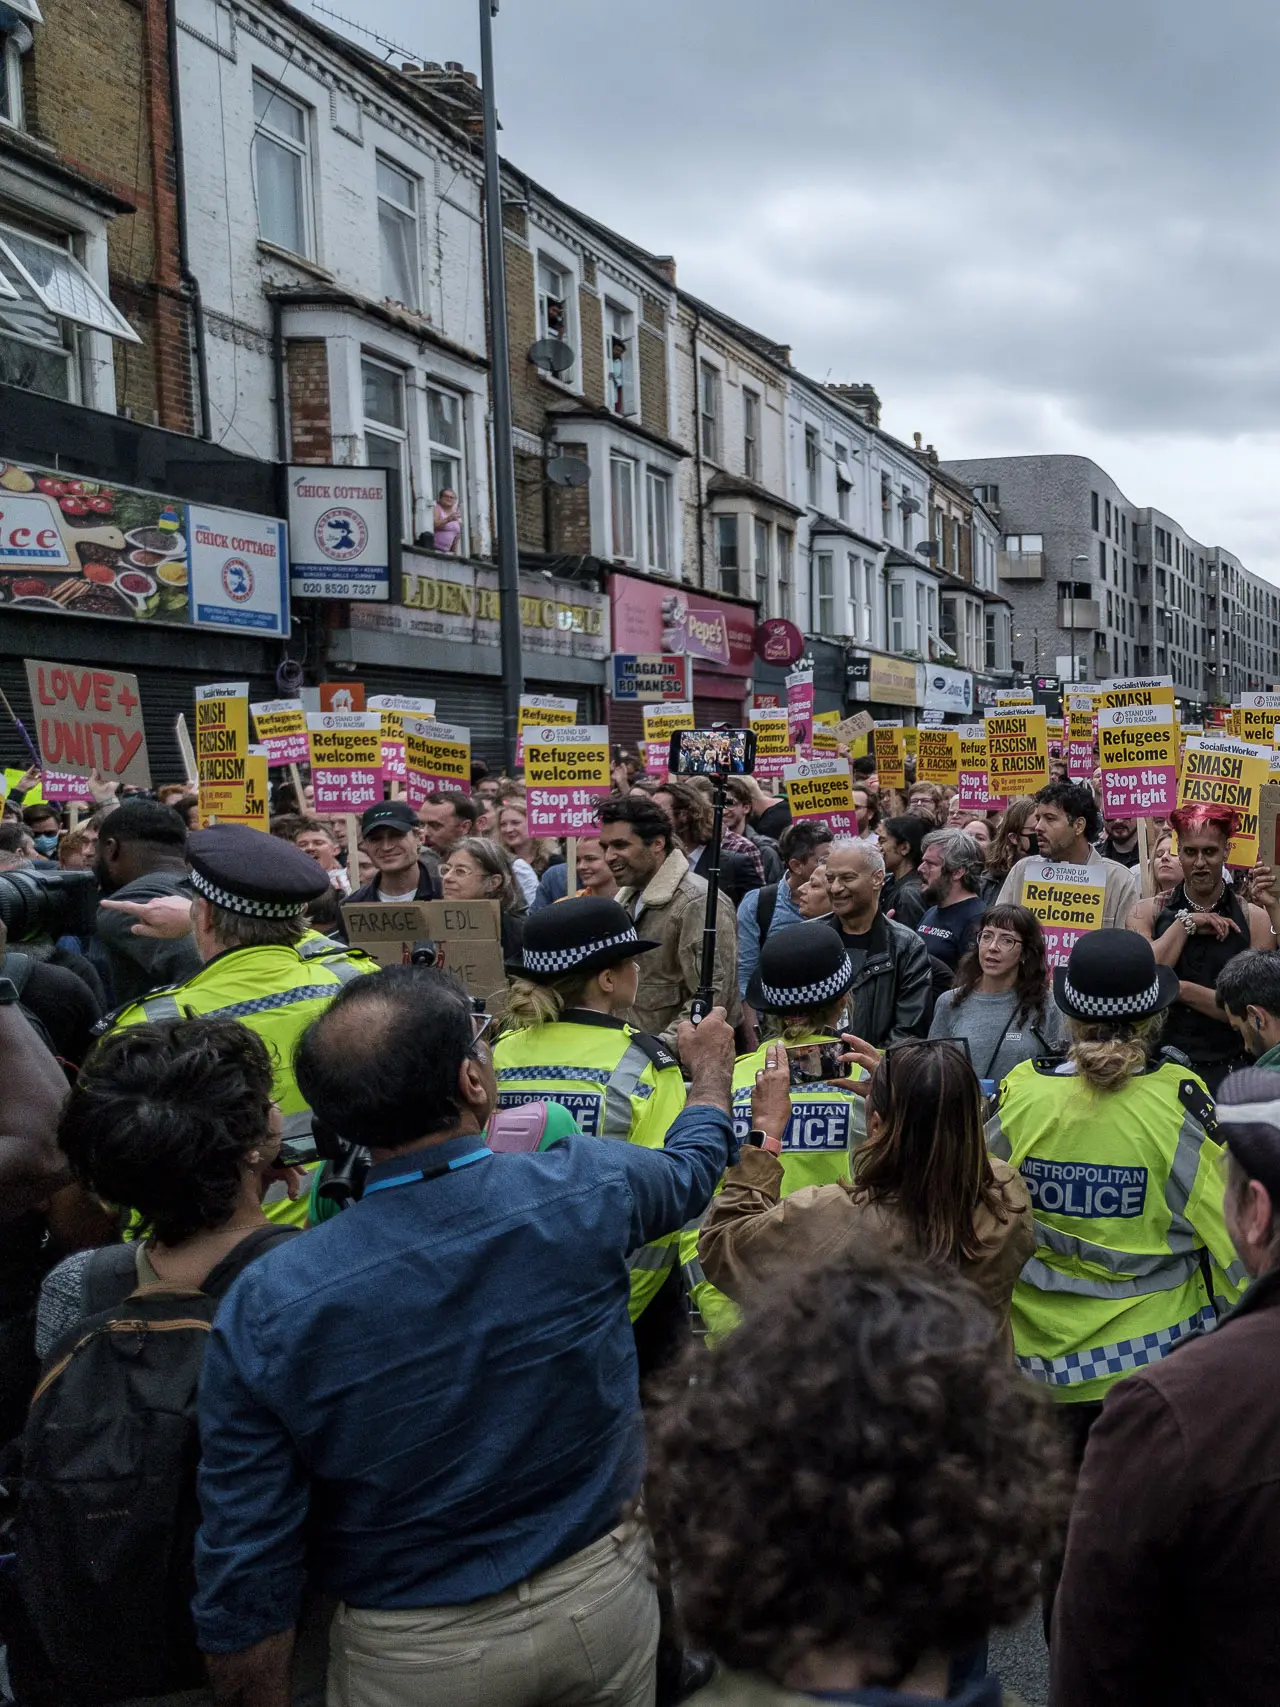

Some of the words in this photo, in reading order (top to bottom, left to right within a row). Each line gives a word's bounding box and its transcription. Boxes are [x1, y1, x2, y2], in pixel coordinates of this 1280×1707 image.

[297, 485, 331, 498] CHICK
[334, 486, 383, 500] COTTAGE
[196, 530, 229, 549] CHICK
[232, 537, 276, 558] COTTAGE
[304, 582, 322, 594] 020
[325, 584, 349, 594] 8520
[352, 584, 377, 595] 7337
[689, 615, 723, 646] Pepe's
[624, 663, 676, 674] MAGAZIN
[37, 667, 115, 711] LOVE
[117, 685, 138, 716] +
[619, 679, 681, 692] ROMANESC
[1106, 692, 1152, 709] SMASH
[257, 713, 303, 726] Refugees
[522, 708, 573, 724] Refugees
[260, 722, 303, 734] welcome
[648, 718, 692, 730] Refugees
[753, 722, 786, 733] Oppose
[988, 719, 1026, 734] SMASH
[264, 738, 284, 752] Stop
[286, 736, 305, 746] the
[313, 732, 378, 748] Refugees
[920, 732, 947, 743] SMASH
[1102, 730, 1170, 747] Refugees
[40, 718, 143, 775] UNITY
[284, 745, 307, 758] right
[407, 736, 468, 760] Refugees
[919, 746, 953, 756] FASCISM
[990, 738, 1036, 753] FASCISM
[315, 750, 376, 763] welcome
[529, 747, 606, 768] Refugees
[1104, 748, 1168, 763] welcome
[408, 754, 464, 774] welcome
[927, 760, 957, 770] RACISM
[990, 760, 999, 772] &
[1003, 756, 1045, 771] RACISM
[1186, 753, 1243, 779] SMASH
[316, 772, 348, 787] Stop
[351, 772, 375, 785] the
[530, 766, 602, 781] welcome
[961, 774, 980, 788] Stop
[1105, 772, 1138, 790] Stop
[1141, 768, 1167, 785] the
[409, 772, 436, 793] Stop
[790, 781, 848, 796] Refugees
[318, 789, 340, 802] far
[342, 787, 376, 804] right
[530, 790, 568, 808] Stop
[961, 790, 973, 801] far
[1107, 791, 1128, 806] far
[1130, 789, 1167, 807] right
[1182, 780, 1252, 807] FASCISM
[794, 796, 848, 810] welcome
[531, 810, 558, 824] far
[831, 814, 850, 828] the
[1065, 875, 1090, 883] RACISM
[1026, 885, 1100, 906] Refugees
[348, 912, 417, 932] FARAGE
[444, 910, 479, 930] EDL
[1021, 1159, 1144, 1184] METROPOLITAN
